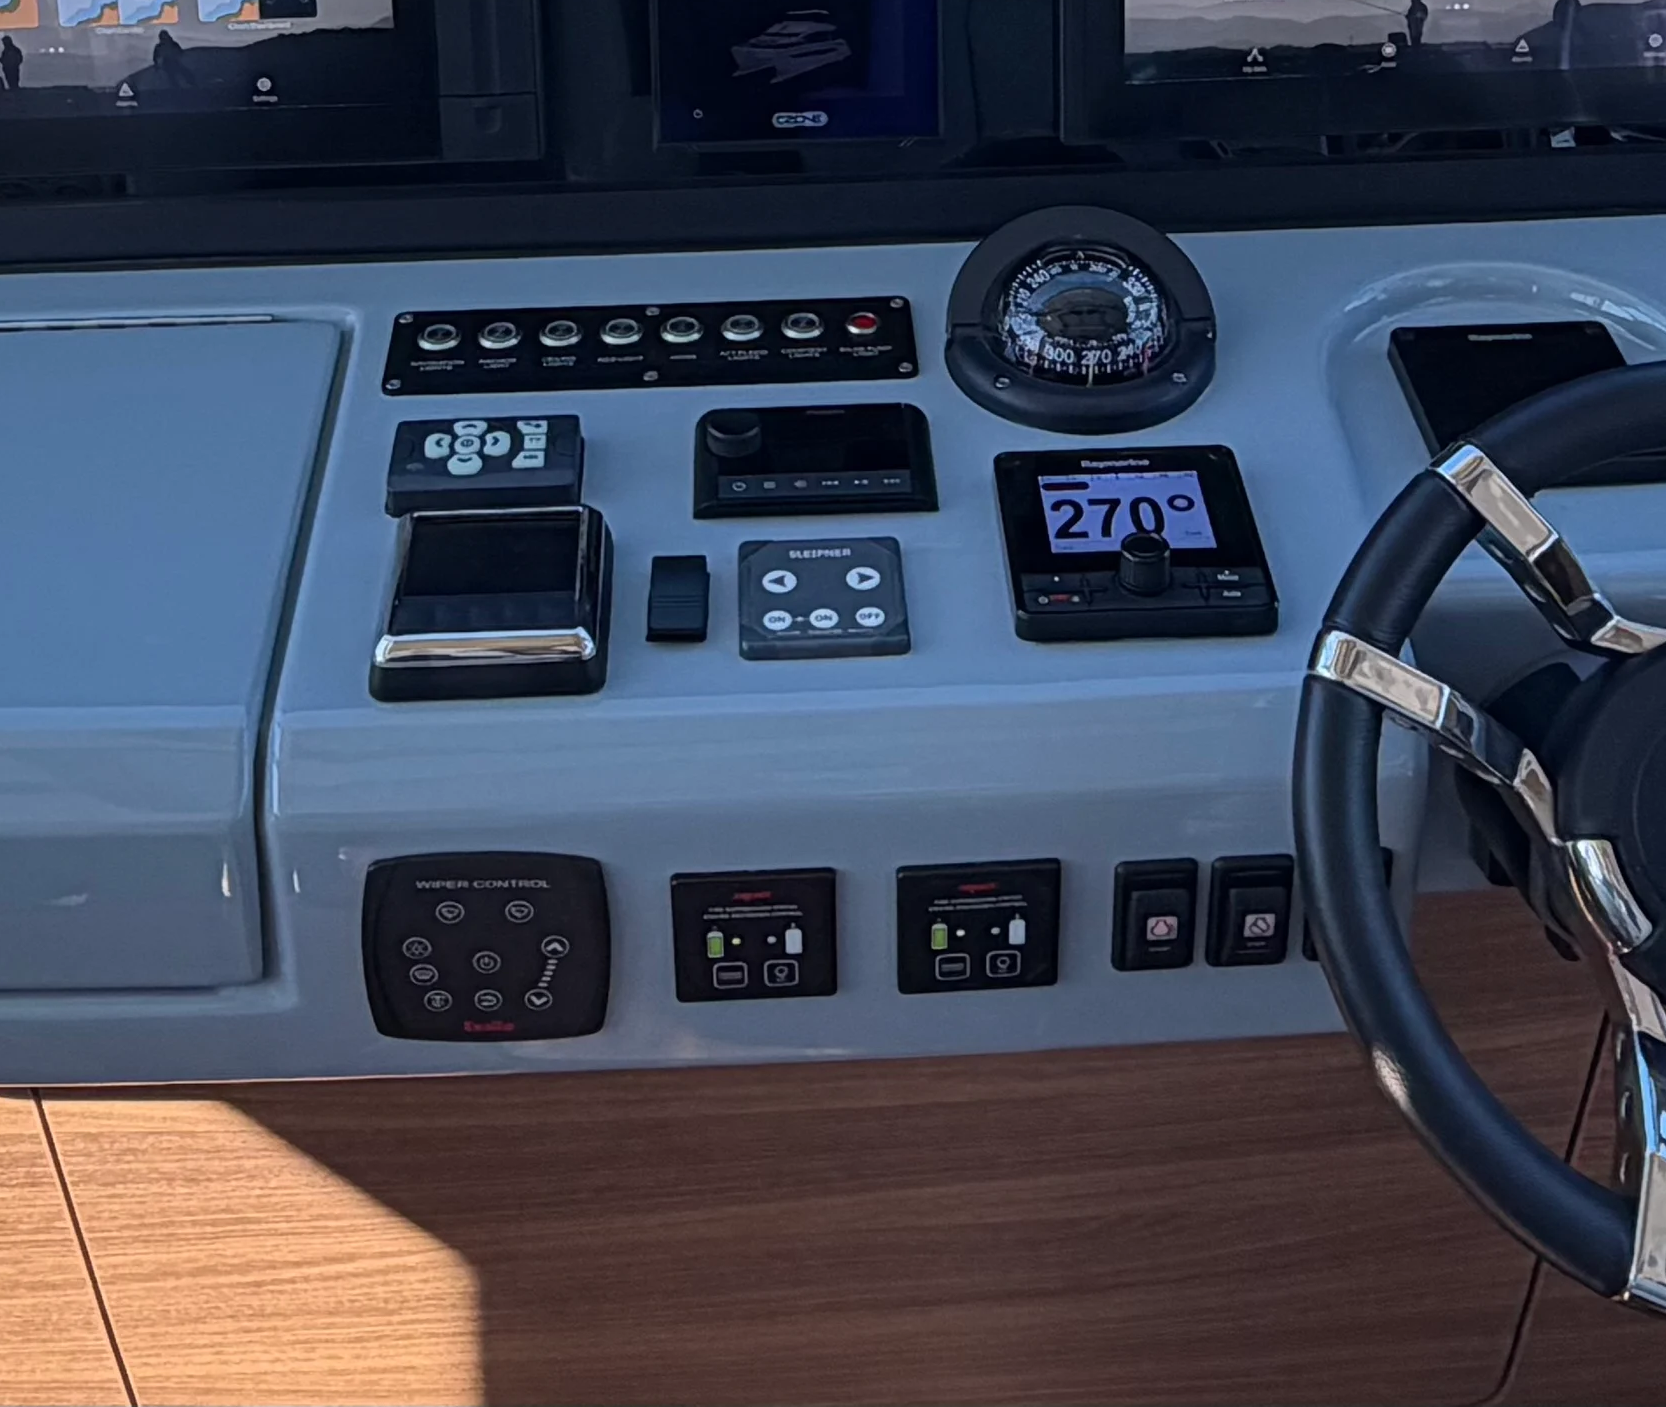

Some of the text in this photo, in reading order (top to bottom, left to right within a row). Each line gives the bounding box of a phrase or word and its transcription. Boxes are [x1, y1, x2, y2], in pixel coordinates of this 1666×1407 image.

[1081, 349, 1112, 364] 270
[1081, 458, 1150, 468] Raymarine
[1049, 494, 1196, 539] 270°
[789, 548, 852, 559] SLEIPNER
[768, 615, 786, 624] ON
[814, 614, 833, 622] ON
[858, 612, 881, 621] OFF
[416, 879, 552, 889] WIPER CONTROL
